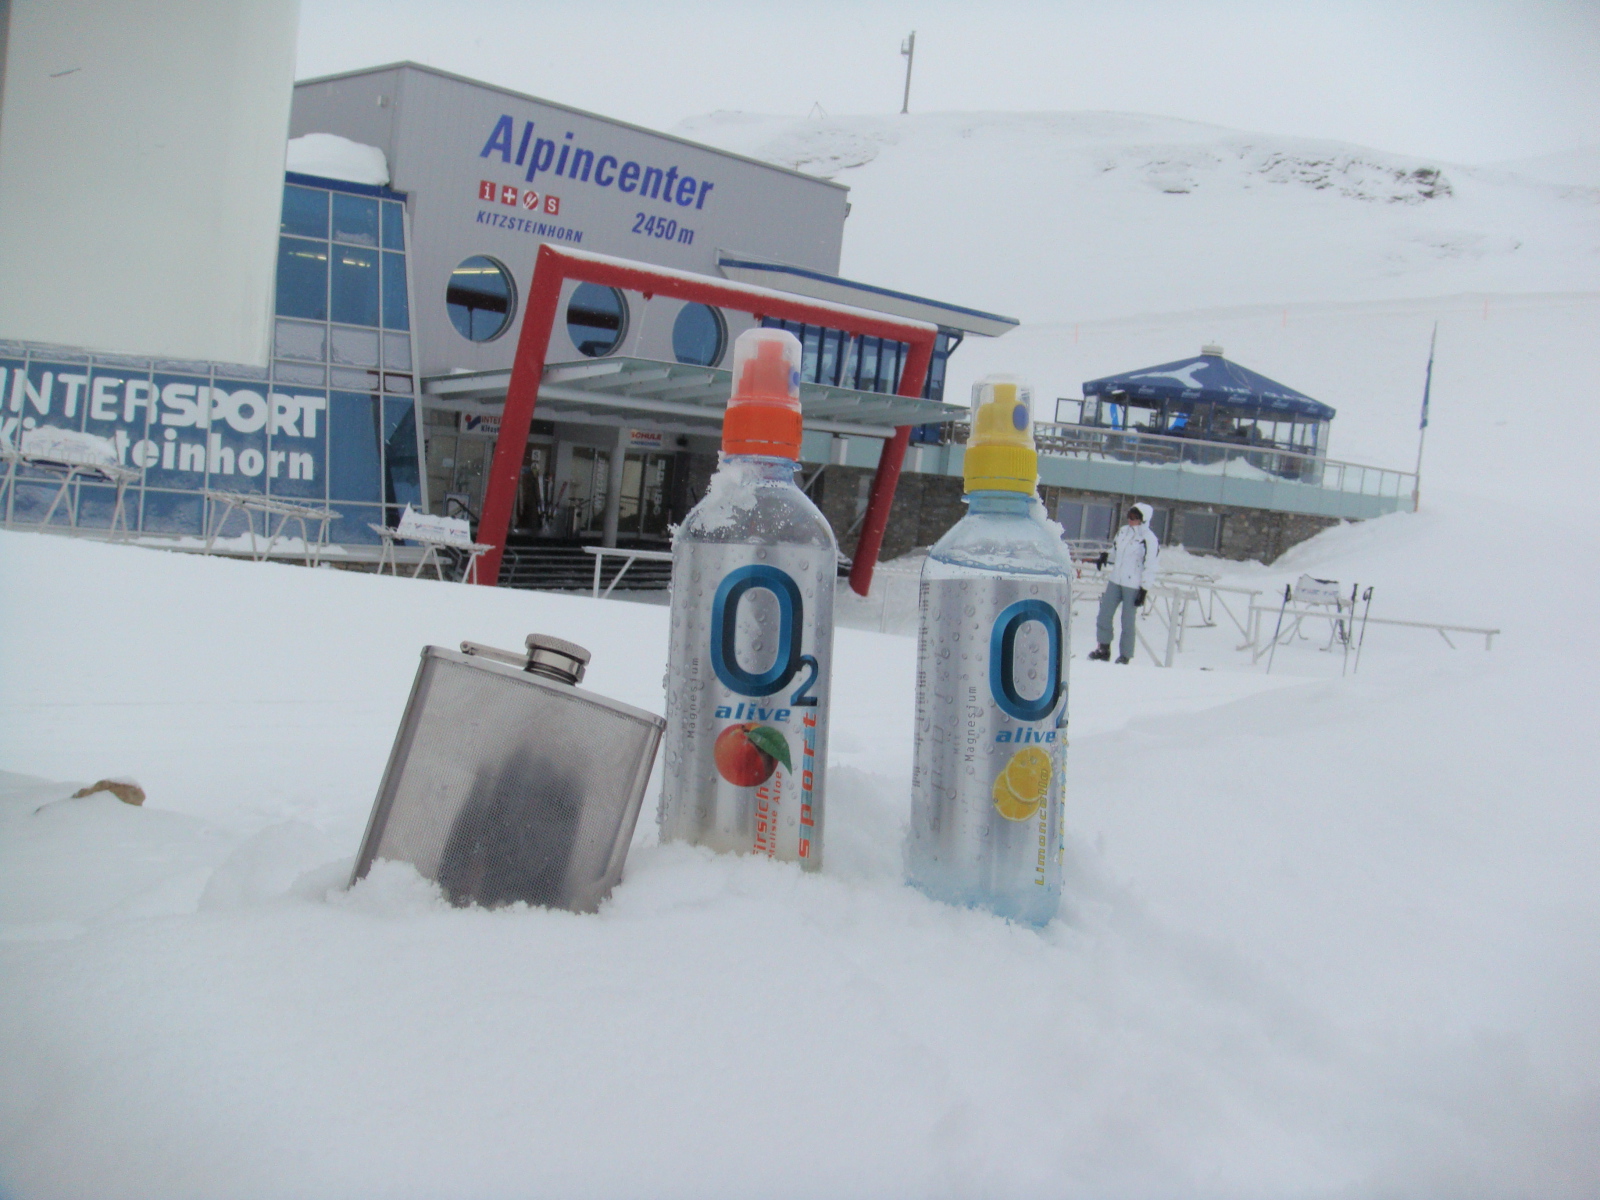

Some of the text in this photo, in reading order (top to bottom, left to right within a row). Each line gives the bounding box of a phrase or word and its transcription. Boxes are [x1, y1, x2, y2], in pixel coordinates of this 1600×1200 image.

[480, 114, 714, 210] Alpincenter
[476, 210, 583, 243] KITZSTEINHORN
[632, 212, 695, 245] 2450 m
[687, 657, 698, 738] Magnesium
[715, 703, 791, 721] alive
[964, 686, 977, 761] Magnesium
[995, 727, 1057, 743] alive
[799, 712, 817, 858] sport
[753, 786, 769, 855] irsich
